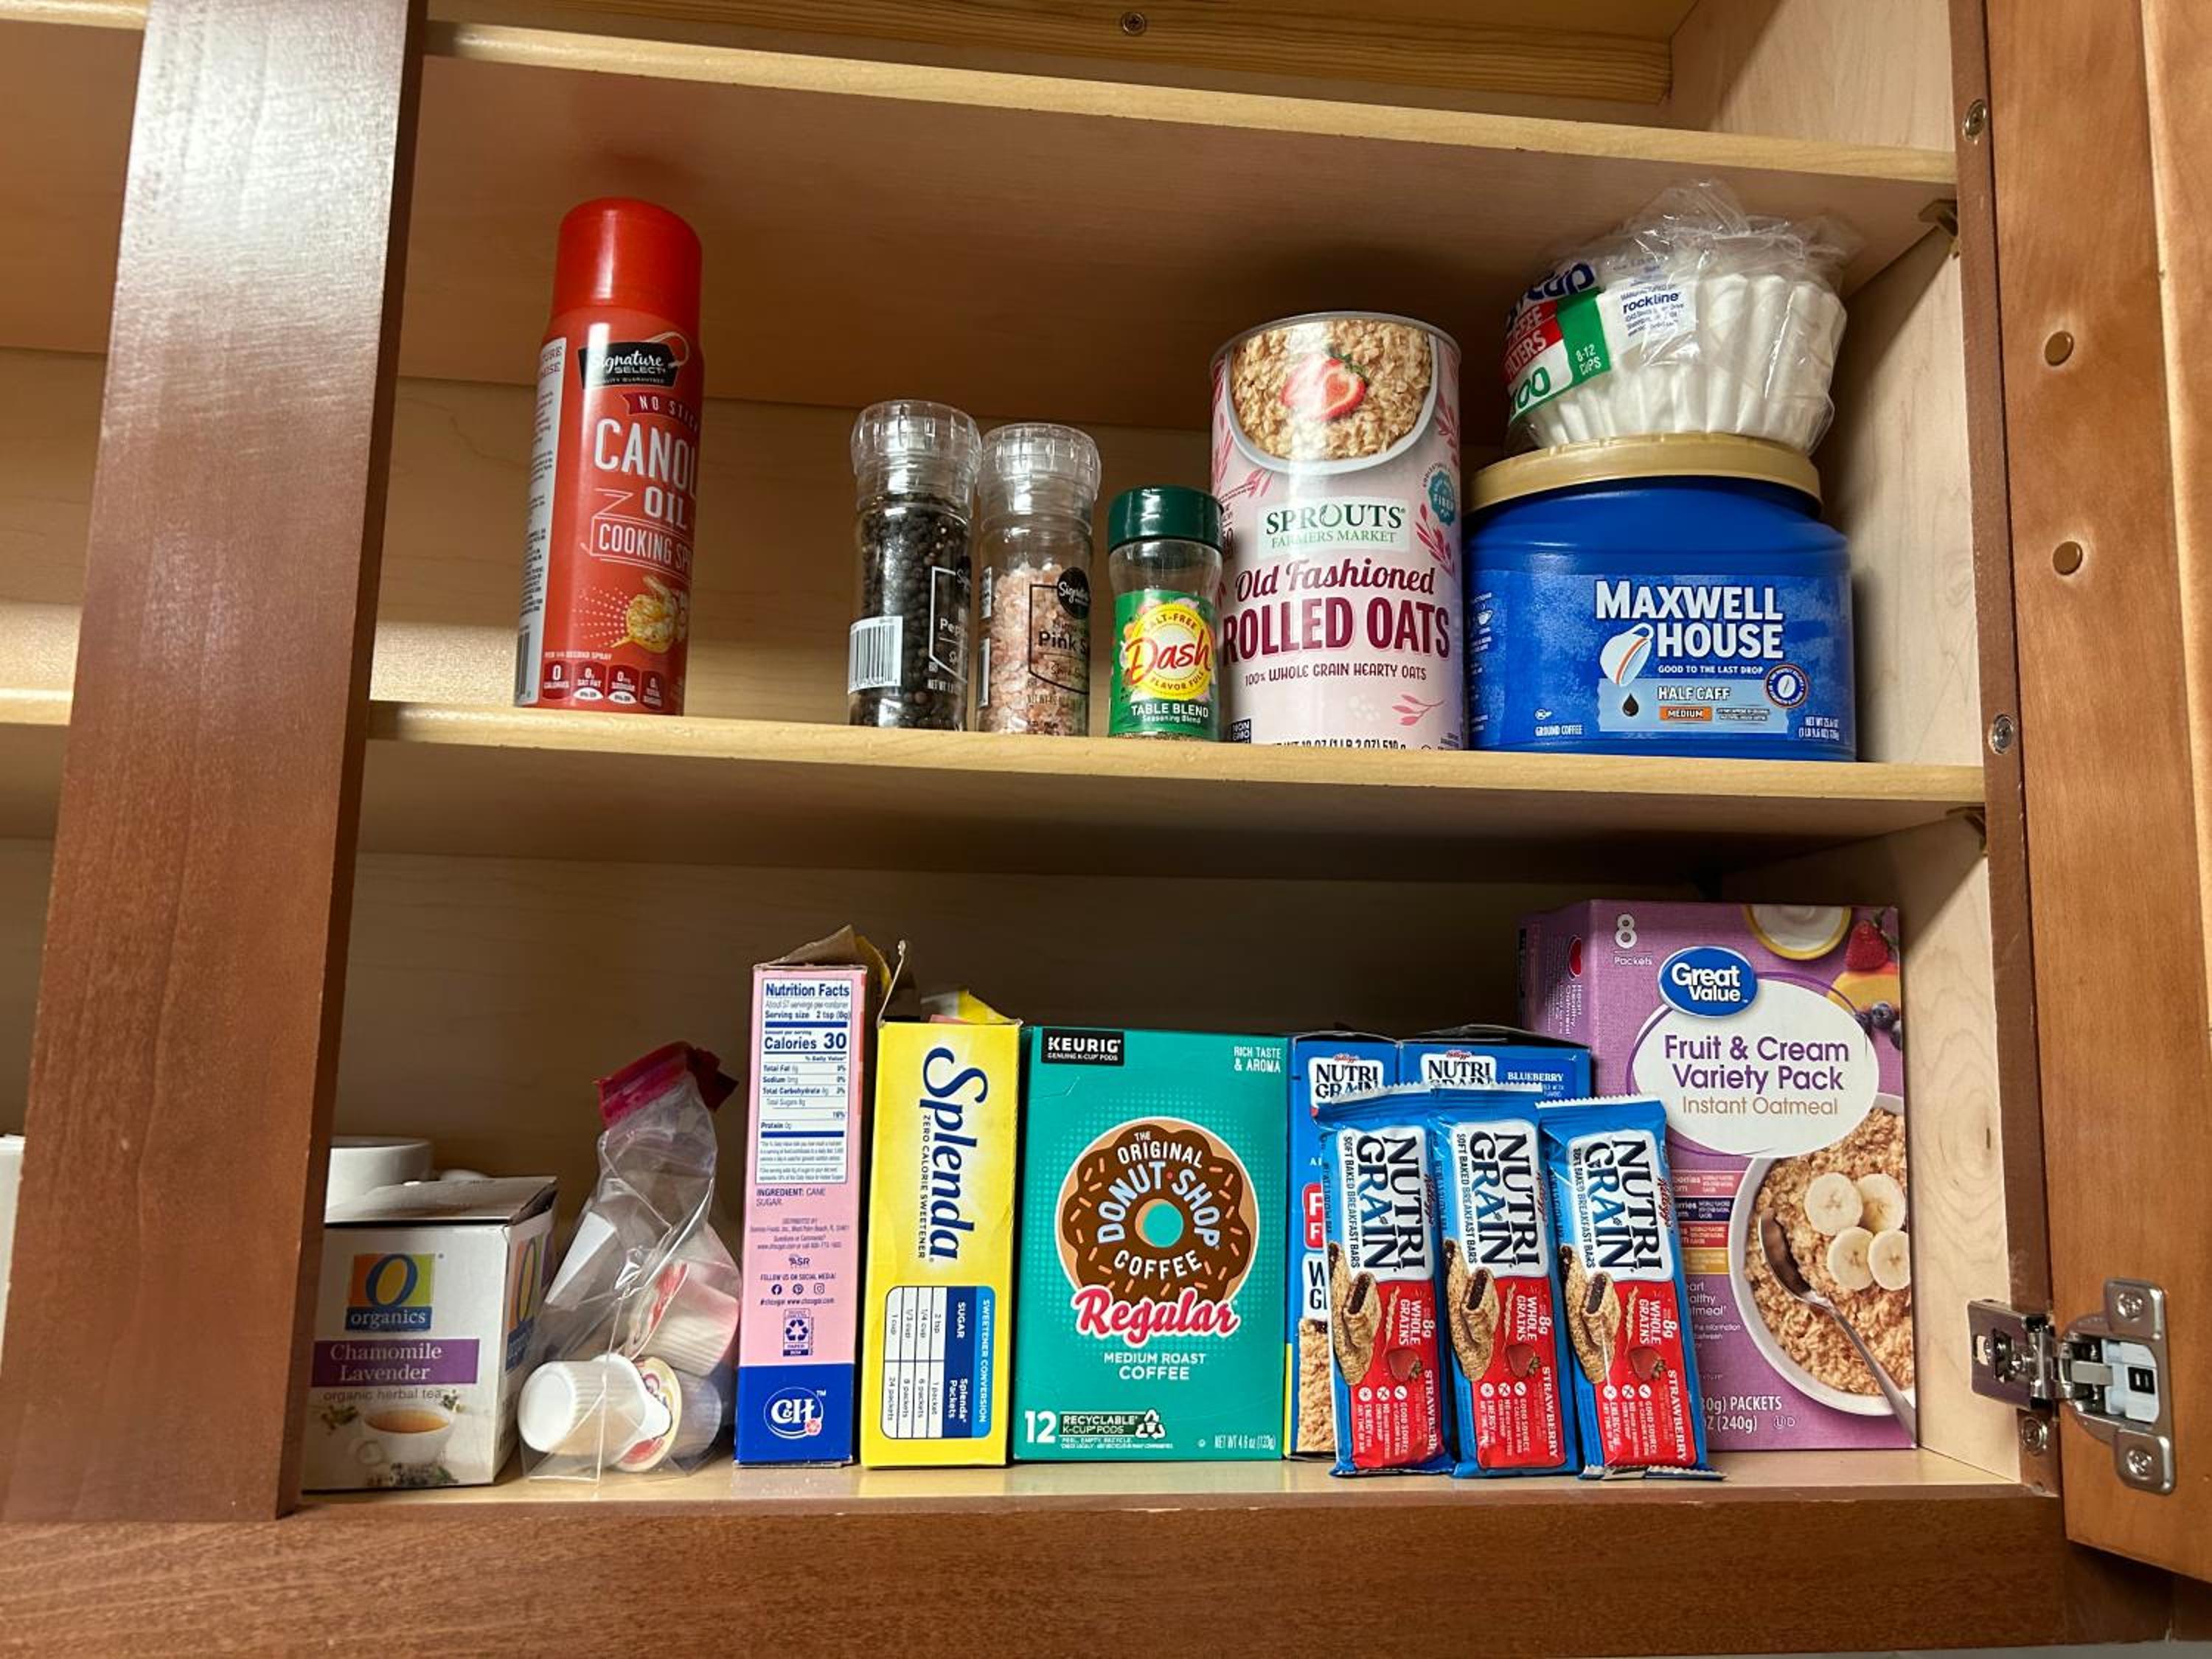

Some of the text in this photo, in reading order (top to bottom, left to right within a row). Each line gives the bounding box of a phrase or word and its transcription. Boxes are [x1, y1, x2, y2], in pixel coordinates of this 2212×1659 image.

[1624, 293, 1679, 313] rockline
[1575, 344, 1596, 362] 8-12
[1579, 356, 1601, 375] CUPS
[639, 395, 659, 411] NO
[643, 485, 686, 529] OIL
[1266, 504, 1404, 535] SPROUTS
[598, 523, 672, 565] COOKING
[1272, 529, 1397, 549] FARMERS MARKET
[1236, 557, 1436, 602] Old Fashioned
[1596, 580, 1784, 621] MAXWELL
[1039, 630, 1074, 653] Pink
[1223, 596, 1451, 663] ROLLED OATS
[1658, 622, 1784, 659] HOUSE
[1124, 628, 1211, 685] Dash
[1245, 662, 1427, 686] 100% WHOLE GRAIN HEARTY OATS
[1658, 665, 1764, 675] GOOD TO THE LAST DROP
[1658, 686, 1731, 701] HALF CAFF
[1130, 703, 1209, 717] TABLE BLEND
[1141, 714, 1180, 723] Seasoning
[1666, 709, 1704, 719] MEDIUM
[1233, 721, 1250, 731] NON
[1535, 725, 1584, 737] GROUND COFFEE
[1614, 914, 1638, 949] 8
[1614, 956, 1653, 965] Packets
[1671, 962, 1741, 988] Great
[765, 983, 850, 996] Nutrition Facts
[1687, 984, 1741, 1003] Value
[765, 1011, 793, 1019] Serving
[822, 1011, 835, 1020] tsp
[764, 1032, 846, 1049] Calories 30
[1048, 1036, 1119, 1053] KEURIG
[1234, 1046, 1281, 1059] RICH TASTE
[1663, 1034, 1850, 1062] Fruit & Cream
[1234, 1059, 1281, 1073] & AROMA
[1315, 1064, 1379, 1083] NUTRI
[1428, 1060, 1491, 1079] NUTRI
[1506, 1071, 1564, 1082] BLUEBERRY
[779, 1087, 821, 1096] Carbohydrate
[1672, 1064, 1845, 1095] Variety Pack
[1682, 1096, 1839, 1116] Instant Oatmeal
[1134, 1131, 1151, 1141] THE
[919, 1046, 989, 1260] Splenda
[1117, 1141, 1203, 1169] ORIGINAL
[756, 1188, 826, 1197] INGREDIENT: CANE
[917, 1114, 931, 1259] ZERO CALORIE SWEETENER
[1457, 1133, 1478, 1264] SOFT BAKED BREAKFAST BARS
[1469, 1130, 1517, 1266] GRAIN
[1096, 1161, 1167, 1245] DONUT
[1171, 1169, 1221, 1248] SHOP
[1343, 1135, 1360, 1268] SOFT BAKED BREAKFAST BARS
[1356, 1134, 1402, 1271] GRAIN
[1381, 1135, 1426, 1269] NUTRI
[1493, 1132, 1540, 1266] NUTRI
[1573, 1147, 1596, 1269] SOFT BAKED BREAKFAST BARS
[1585, 1141, 1638, 1269] GRAIN
[1611, 1139, 1663, 1270] NUTRI
[1113, 1250, 1203, 1279] COFFEE
[365, 1253, 418, 1308] O
[350, 1310, 426, 1328] organics
[956, 1301, 966, 1338] SUGAR
[1074, 1287, 1239, 1345] Regular
[1398, 1298, 1411, 1346] GRAINS
[1409, 1300, 1422, 1346] WHOLE
[1515, 1295, 1527, 1342] GRAINS
[1527, 1296, 1538, 1341] WHOLE
[1539, 1315, 1552, 1335] 8g
[1638, 1298, 1650, 1345] GRAINS
[1649, 1299, 1662, 1346] WHOLE
[1422, 1319, 1436, 1338] 8g
[1662, 1319, 1677, 1338] 8g
[330, 1343, 442, 1361] Chamomile
[978, 1298, 990, 1423] SWEETENER CONVERSION
[1104, 1352, 1206, 1364] MEDIUM ROAST
[340, 1366, 431, 1382] Lavender
[1118, 1365, 1190, 1380] COFFEE
[323, 1389, 442, 1405] organic herbal tea
[948, 1380, 958, 1419] Packets
[959, 1378, 967, 1422] Splenda
[1730, 1395, 1782, 1411] PACKETS
[771, 1399, 815, 1424] C&H
[1062, 1415, 1135, 1425] RECYCLABLE
[1542, 1366, 1559, 1458] STRAWBERRY
[1666, 1368, 1687, 1461] STRAWBERRY
[1024, 1410, 1057, 1443] 12
[1062, 1425, 1124, 1433] K-CUP PODS
[1717, 1415, 1758, 1434] (240g)
[1215, 1435, 1237, 1449] NET WT
